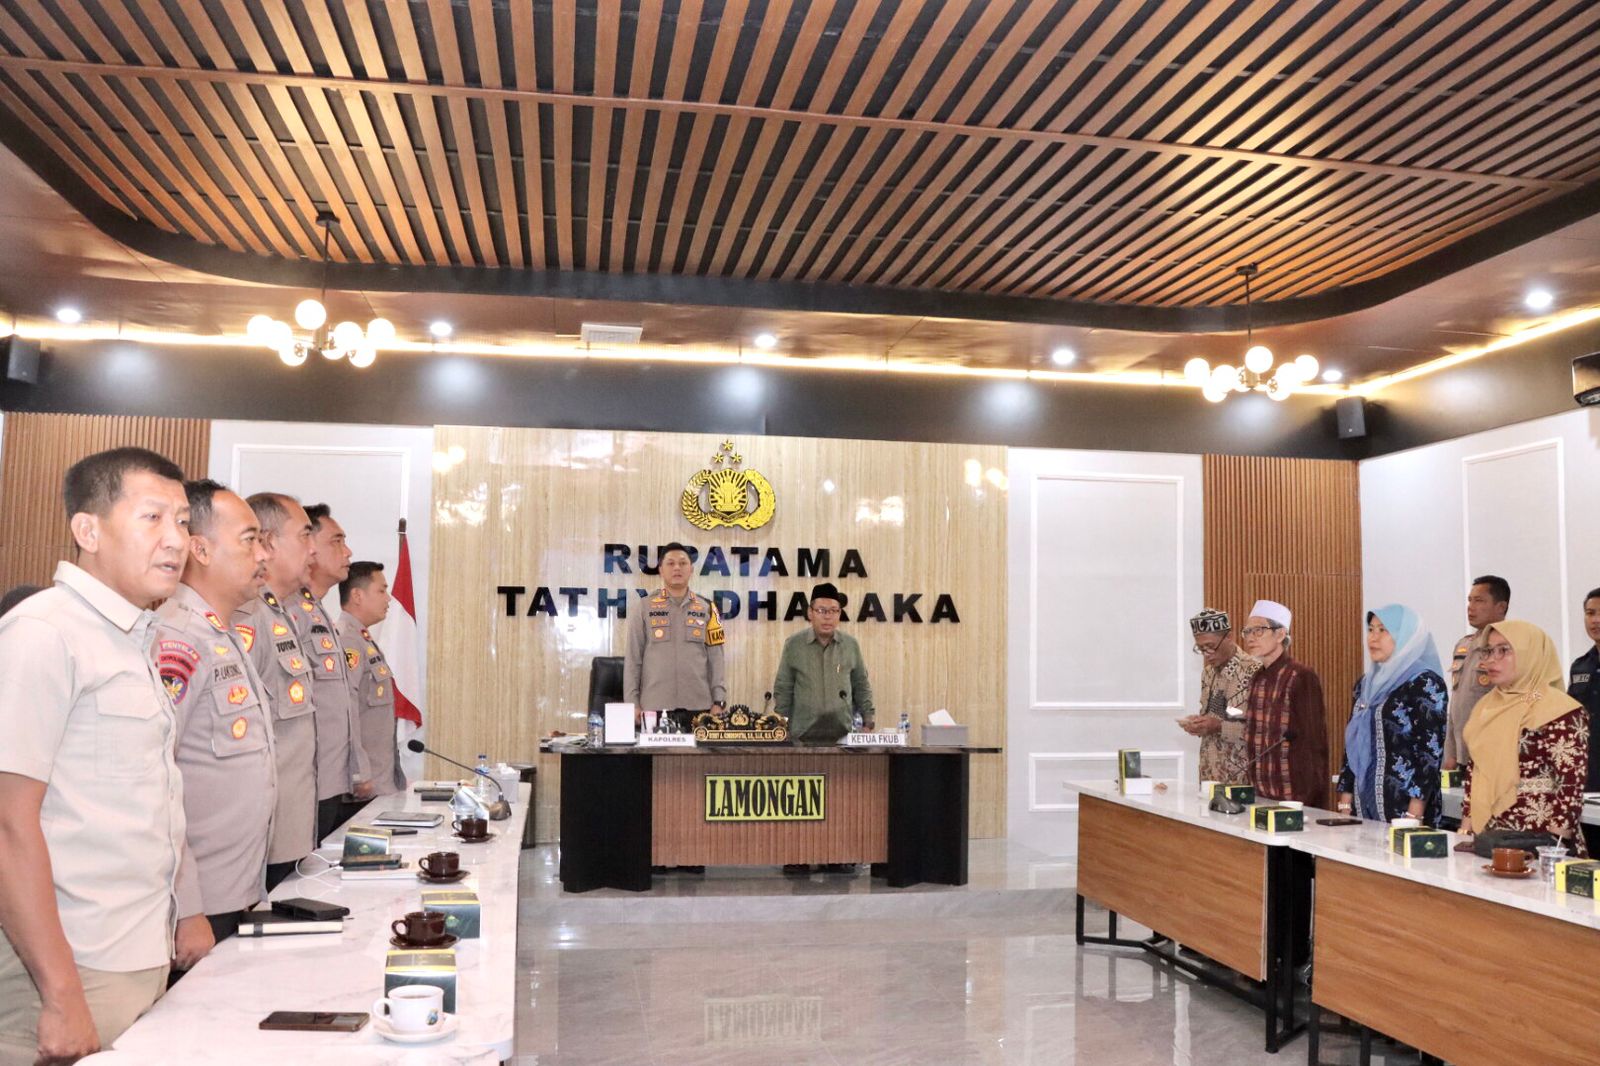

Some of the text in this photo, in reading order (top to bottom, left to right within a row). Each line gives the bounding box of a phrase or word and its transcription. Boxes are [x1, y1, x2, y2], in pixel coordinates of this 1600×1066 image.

[851, 734, 899, 744] KETUA FKUB
[709, 778, 822, 817] LAMONGAN
